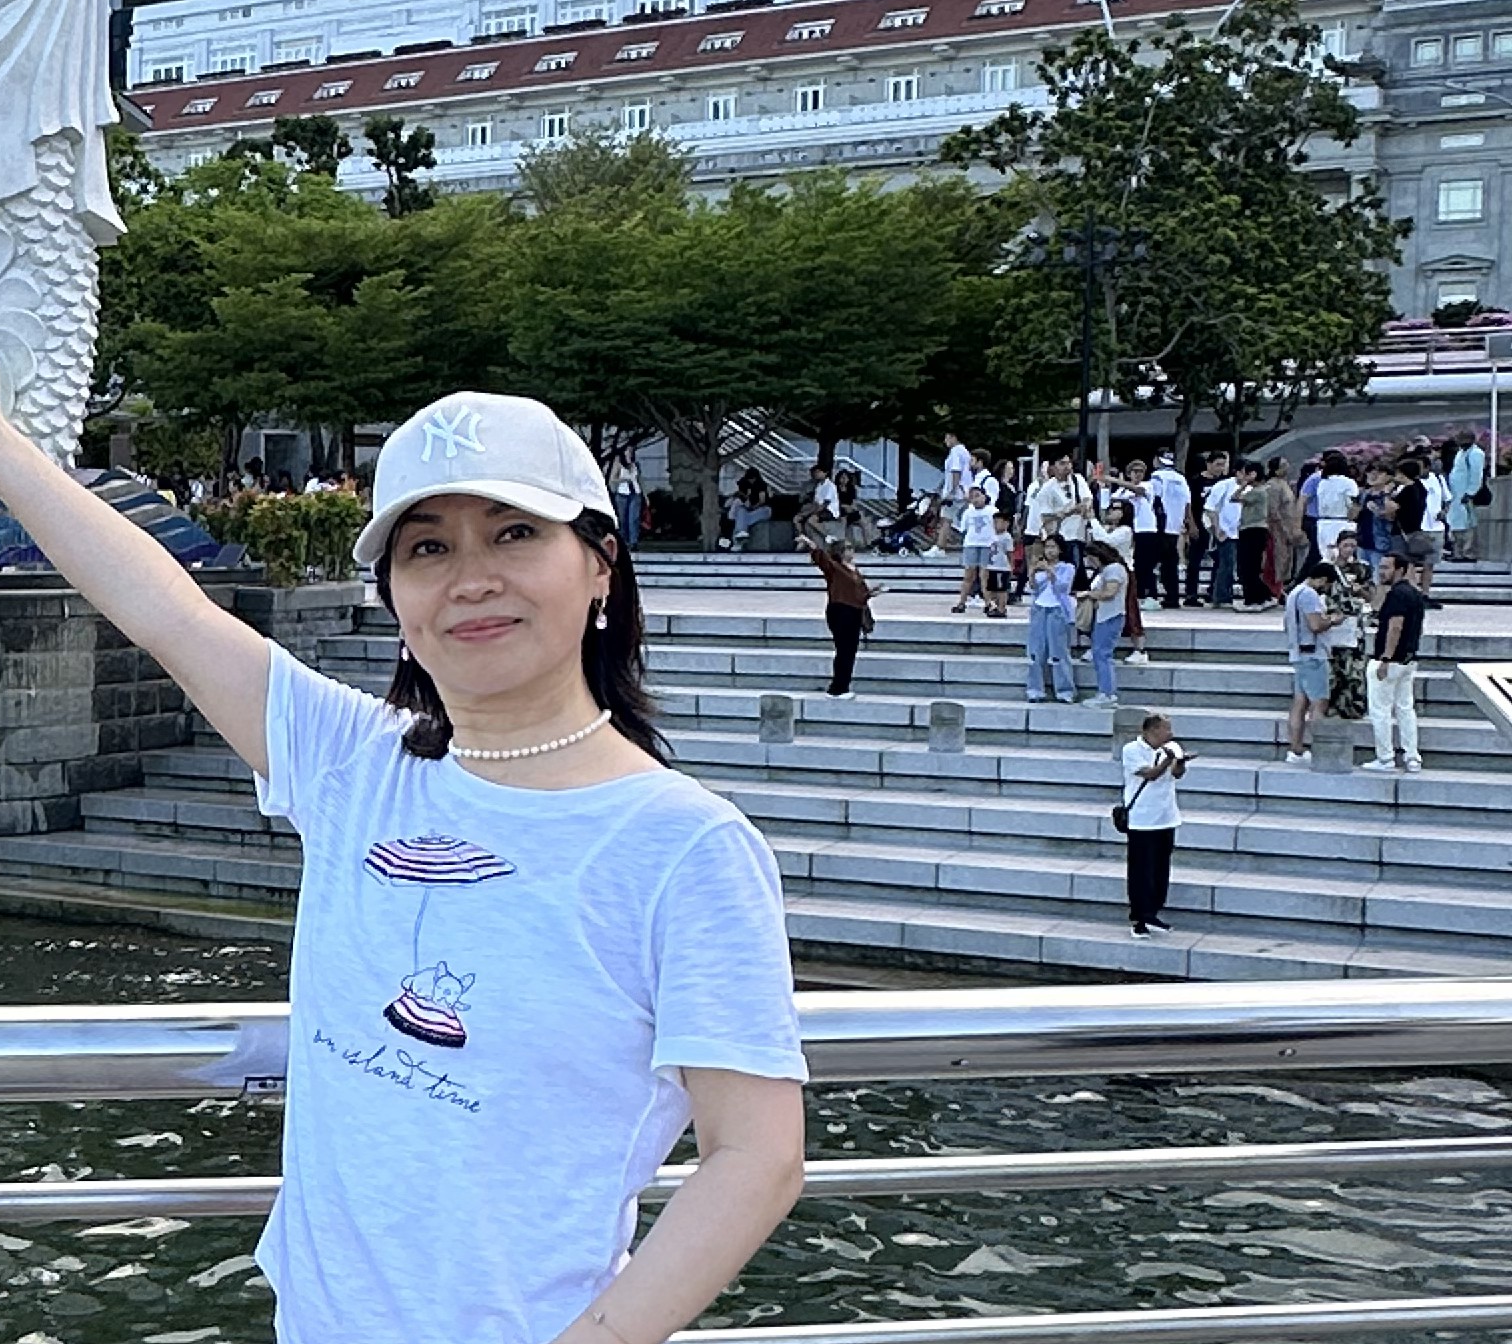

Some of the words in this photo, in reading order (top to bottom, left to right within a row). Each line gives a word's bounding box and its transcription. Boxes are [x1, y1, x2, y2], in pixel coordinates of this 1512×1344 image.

[313, 1029, 336, 1053] on
[342, 1045, 417, 1089] island
[421, 1070, 482, 1113] time
